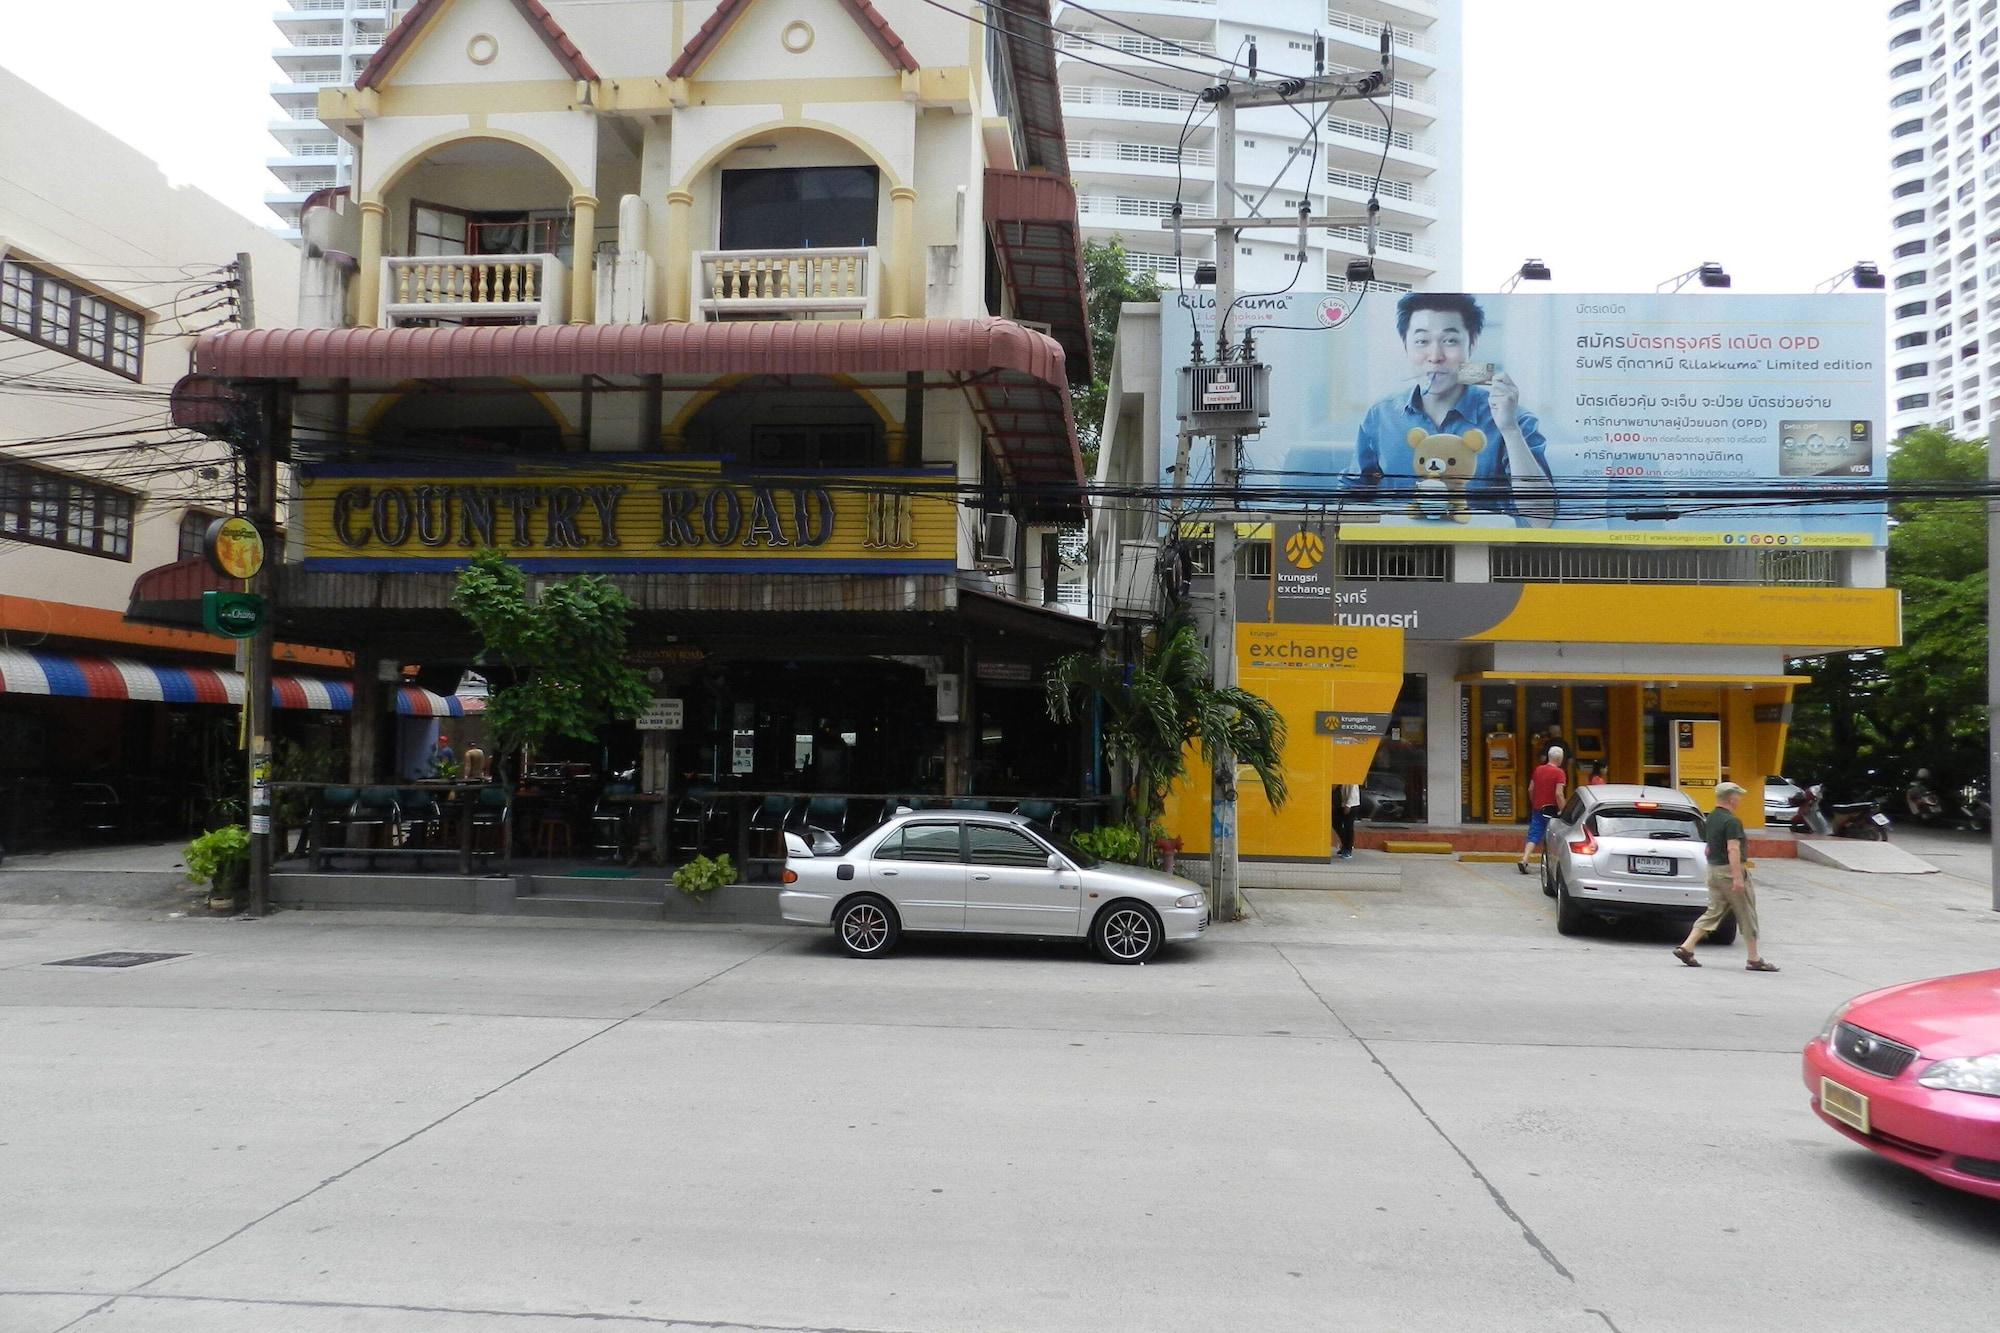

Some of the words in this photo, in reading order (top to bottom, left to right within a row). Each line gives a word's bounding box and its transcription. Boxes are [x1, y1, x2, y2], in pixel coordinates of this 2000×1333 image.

[1576, 303, 1626, 314] บัตรเดบิต
[1576, 332, 1722, 353] สมัครบัตรกรุงศรี
[1728, 333, 1772, 350] เดบิต
[1778, 336, 1820, 350] OPD
[1576, 356, 1613, 369] รับฟรี
[1766, 359, 1819, 370] Limited
[1823, 359, 1873, 371] edition
[1576, 394, 1656, 410] บัตรเดียวคุ้ม
[1661, 394, 1697, 407] จะเจ็บ
[1702, 395, 1744, 408] จะป่วย
[1748, 395, 1832, 408] บัตรช่วยจ่าย
[1731, 418, 1768, 430] (OPD)
[1604, 432, 1641, 443] 1,000
[1604, 466, 1644, 477] 5,000
[1850, 465, 1870, 473] VISA
[333, 484, 628, 549] COUNTRY
[656, 487, 835, 548] ROAD
[1277, 573, 1318, 584] krungsri
[1277, 585, 1331, 595] exchange
[1335, 588, 1367, 607] รุงศรี
[1334, 610, 1418, 629] rungsri
[1250, 641, 1359, 662] exchange
[1341, 723, 1377, 731] exchange
